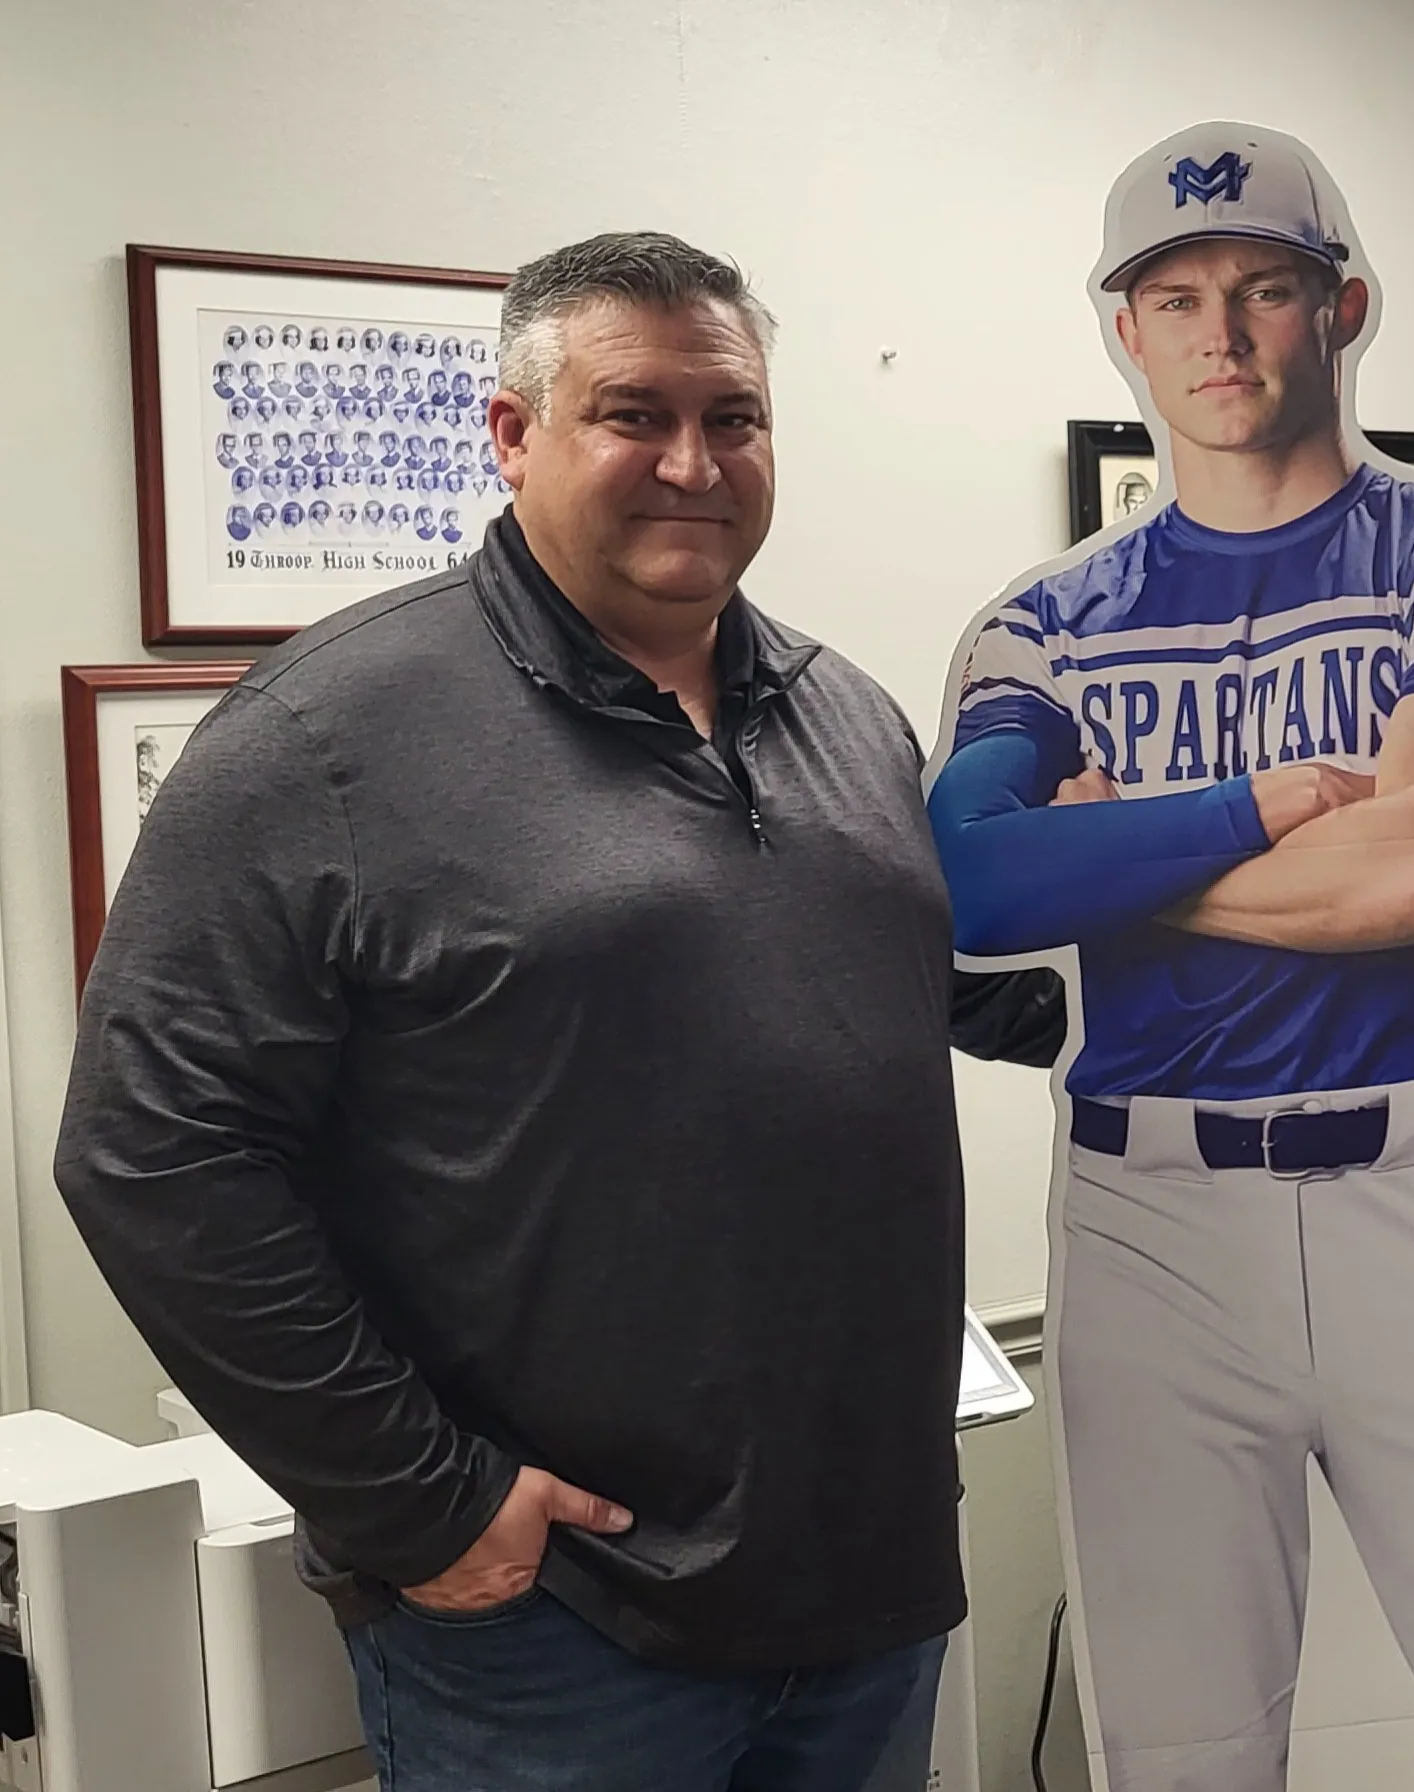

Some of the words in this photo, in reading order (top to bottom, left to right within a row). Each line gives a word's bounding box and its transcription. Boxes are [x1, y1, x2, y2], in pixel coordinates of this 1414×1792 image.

[227, 549, 245, 569] 19
[322, 549, 366, 571] HIGH
[373, 550, 437, 571] SCHOOL
[1082, 645, 1404, 786] SPARTANS
